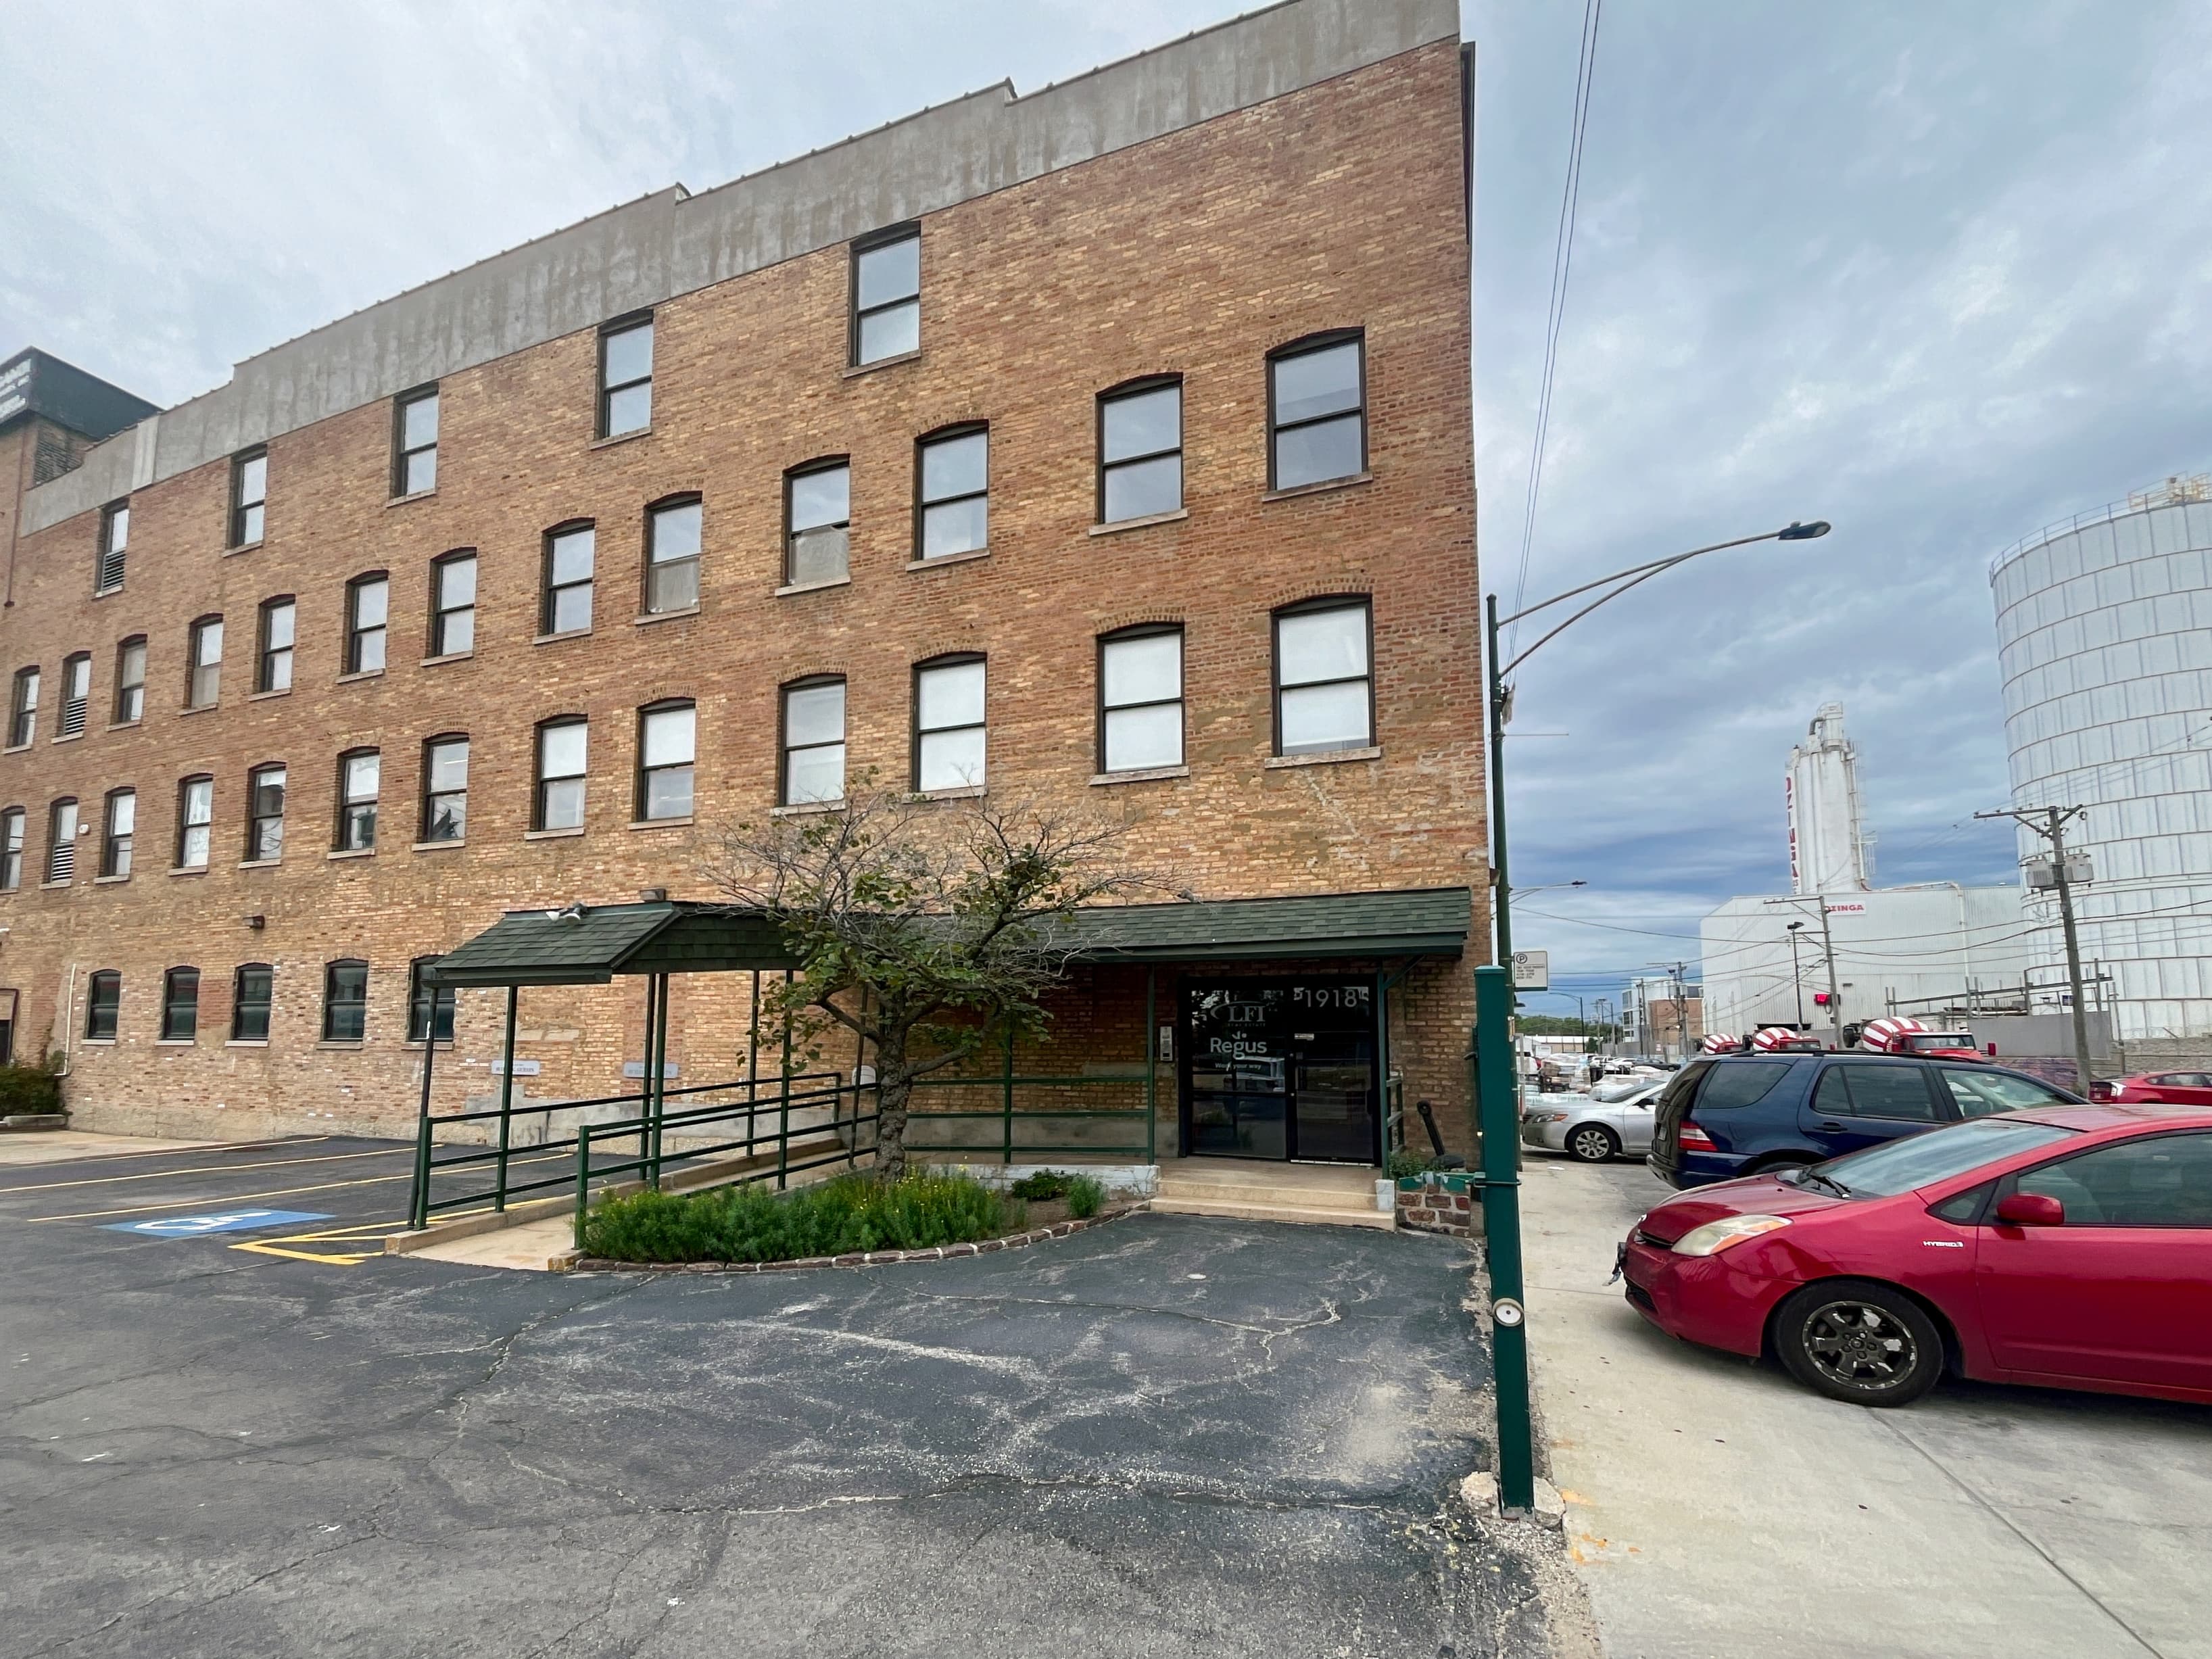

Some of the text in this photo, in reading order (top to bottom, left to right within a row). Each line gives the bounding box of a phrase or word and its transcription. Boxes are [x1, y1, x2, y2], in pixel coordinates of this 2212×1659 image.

[1305, 989, 1357, 1008] 1918
[1227, 1005, 1266, 1022] LFI
[1210, 1036, 1268, 1061] Regus
